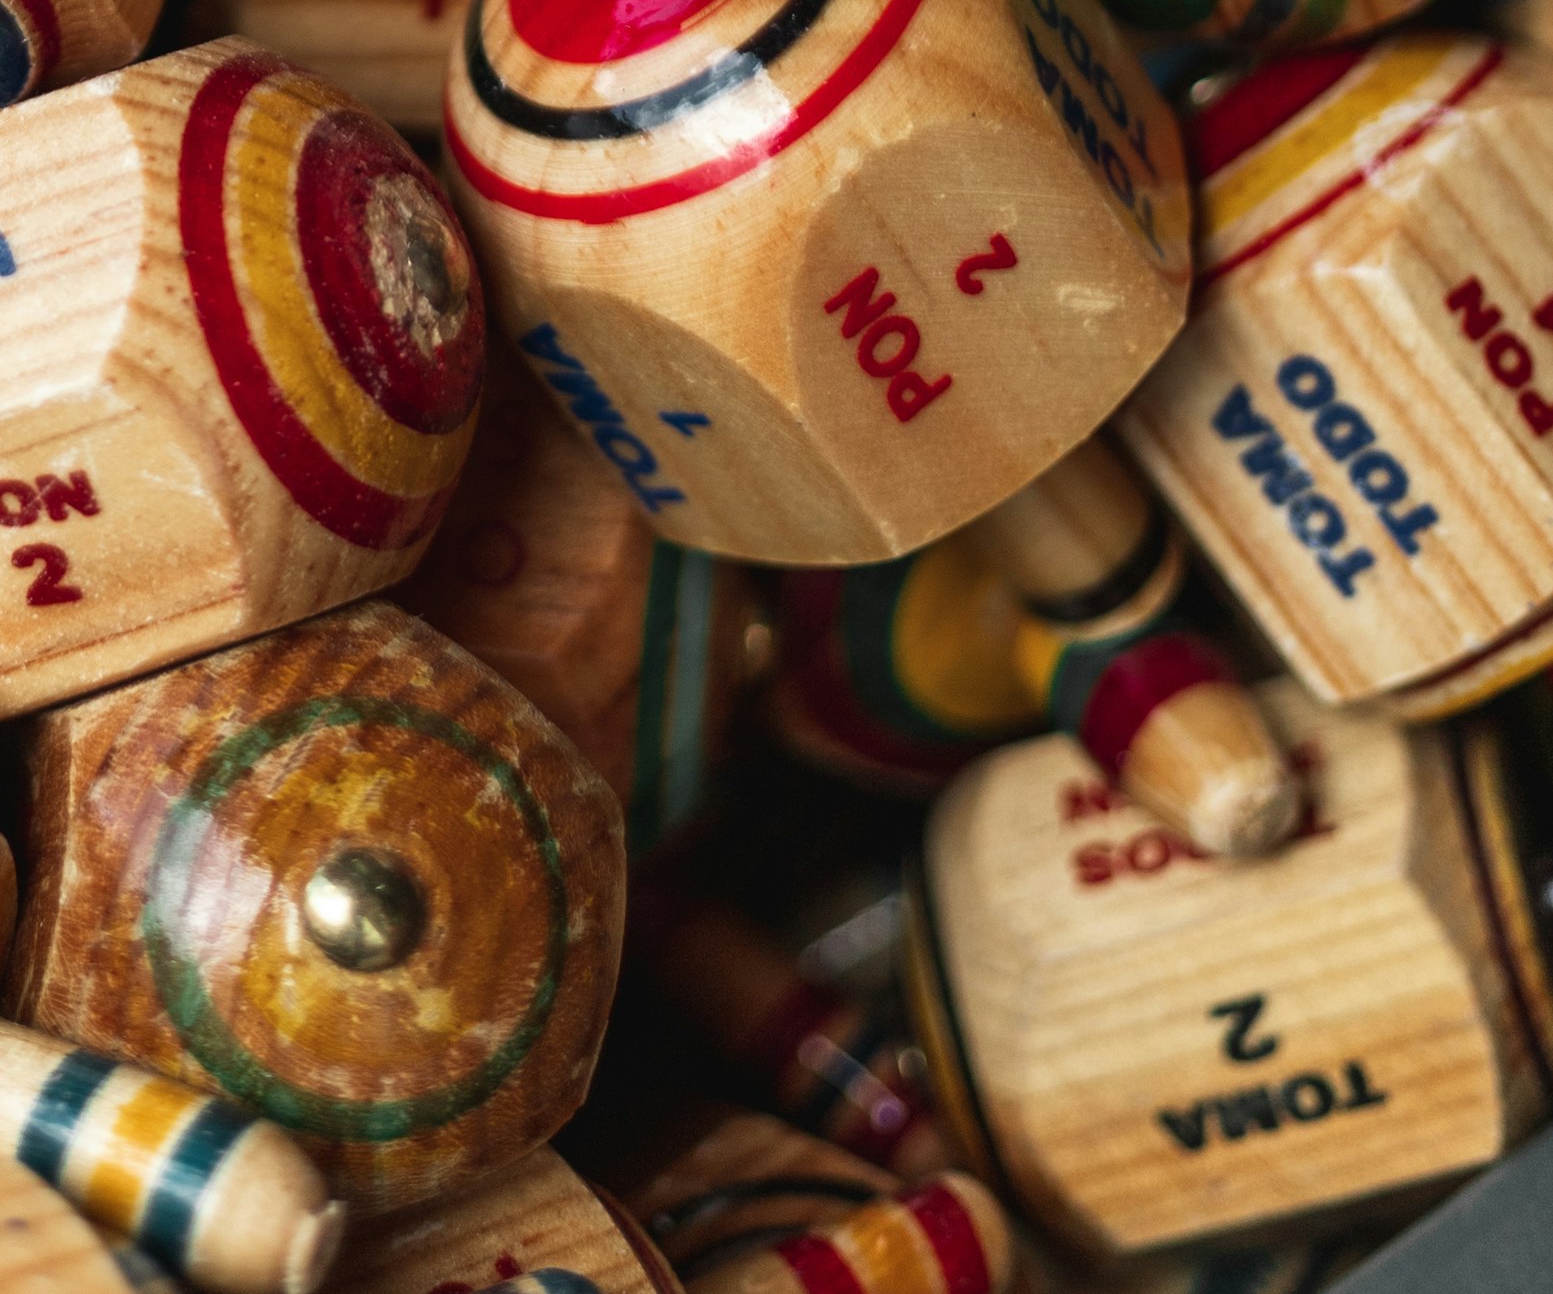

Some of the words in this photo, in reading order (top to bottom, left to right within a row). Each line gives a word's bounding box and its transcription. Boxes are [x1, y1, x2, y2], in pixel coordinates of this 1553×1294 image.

[954, 232, 1019, 296] 2
[823, 266, 952, 424] PON
[520, 322, 687, 513] TOMA
[658, 411, 711, 437] 1
[1276, 353, 1438, 556] TODO
[1211, 383, 1375, 599] TOMA
[12, 543, 82, 607] 2
[1208, 994, 1277, 1064] 2
[1156, 1059, 1387, 1153] TOMA
